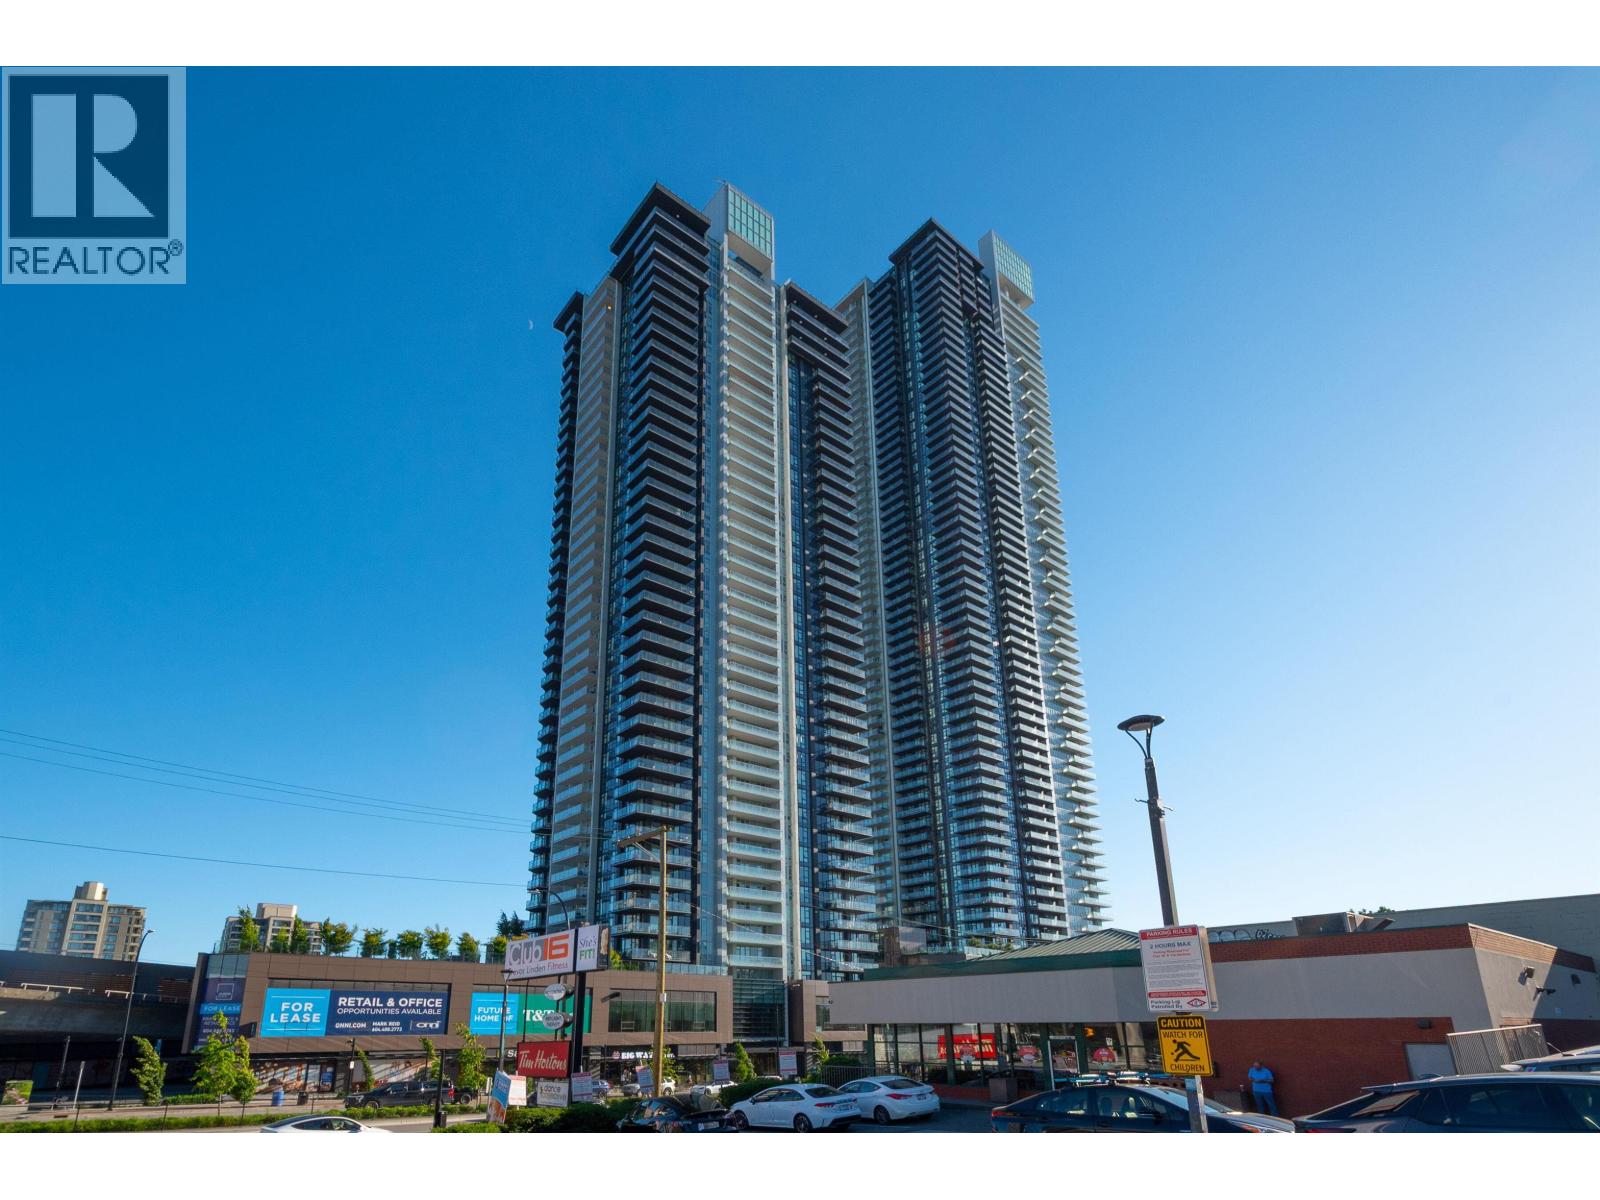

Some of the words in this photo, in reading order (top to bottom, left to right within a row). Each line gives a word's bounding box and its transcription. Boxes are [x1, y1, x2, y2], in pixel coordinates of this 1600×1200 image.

[1146, 929, 1172, 937] PARKING
[580, 936, 597, 948] She's
[527, 965, 545, 973] Linden
[547, 962, 569, 970] Fitness
[338, 997, 383, 1007] RETAIL
[386, 998, 395, 1007] &
[398, 998, 443, 1007] OFFICE
[281, 1002, 314, 1012] FOR
[337, 1007, 400, 1015] OPPORTUNITIES
[270, 1013, 321, 1023] LEASE
[1160, 1019, 1202, 1028] CAUTION
[1162, 1031, 1187, 1039] WATCH
[621, 1051, 635, 1060] BIG
[519, 1050, 533, 1069] Tim
[534, 1049, 567, 1072] Hortons
[1170, 1064, 1205, 1072] CHILDREN
